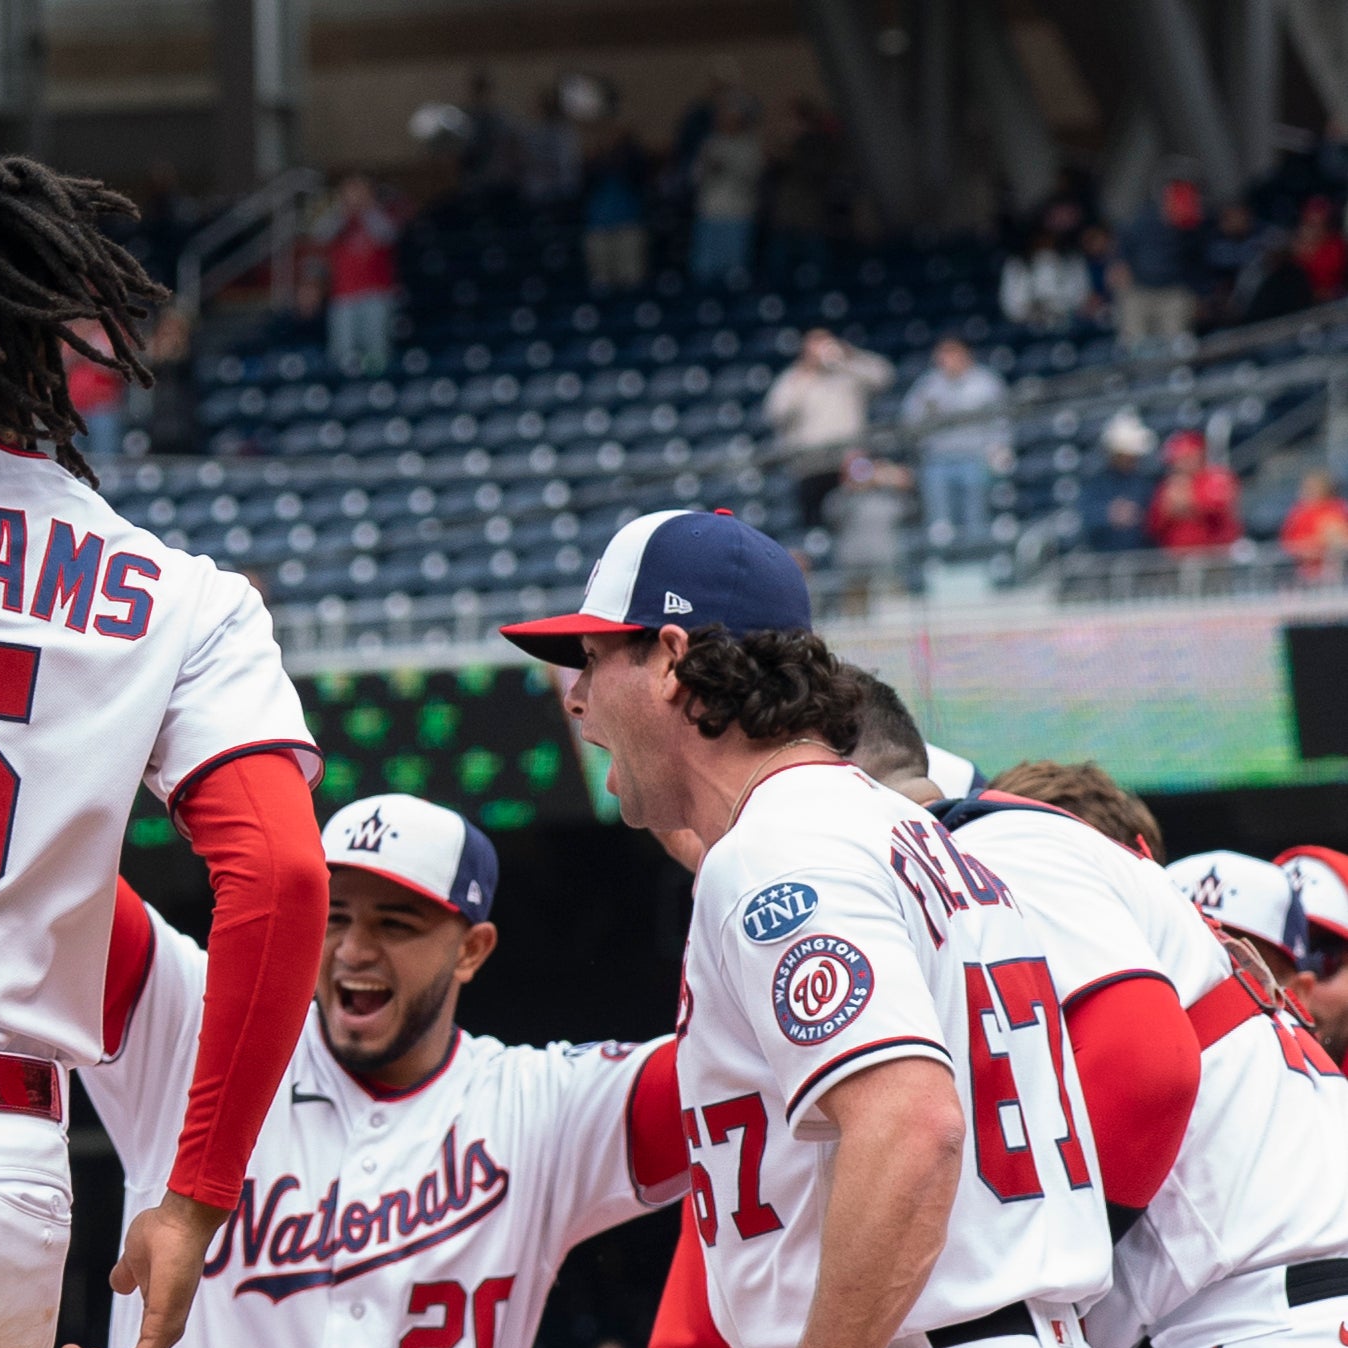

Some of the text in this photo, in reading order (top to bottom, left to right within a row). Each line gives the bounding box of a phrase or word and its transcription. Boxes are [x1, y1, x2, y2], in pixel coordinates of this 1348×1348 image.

[745, 890, 817, 938] TNL
[775, 938, 861, 1003] WASHINGTON
[789, 987, 868, 1039] NATIONALS
[203, 1123, 509, 1280] Natonals
